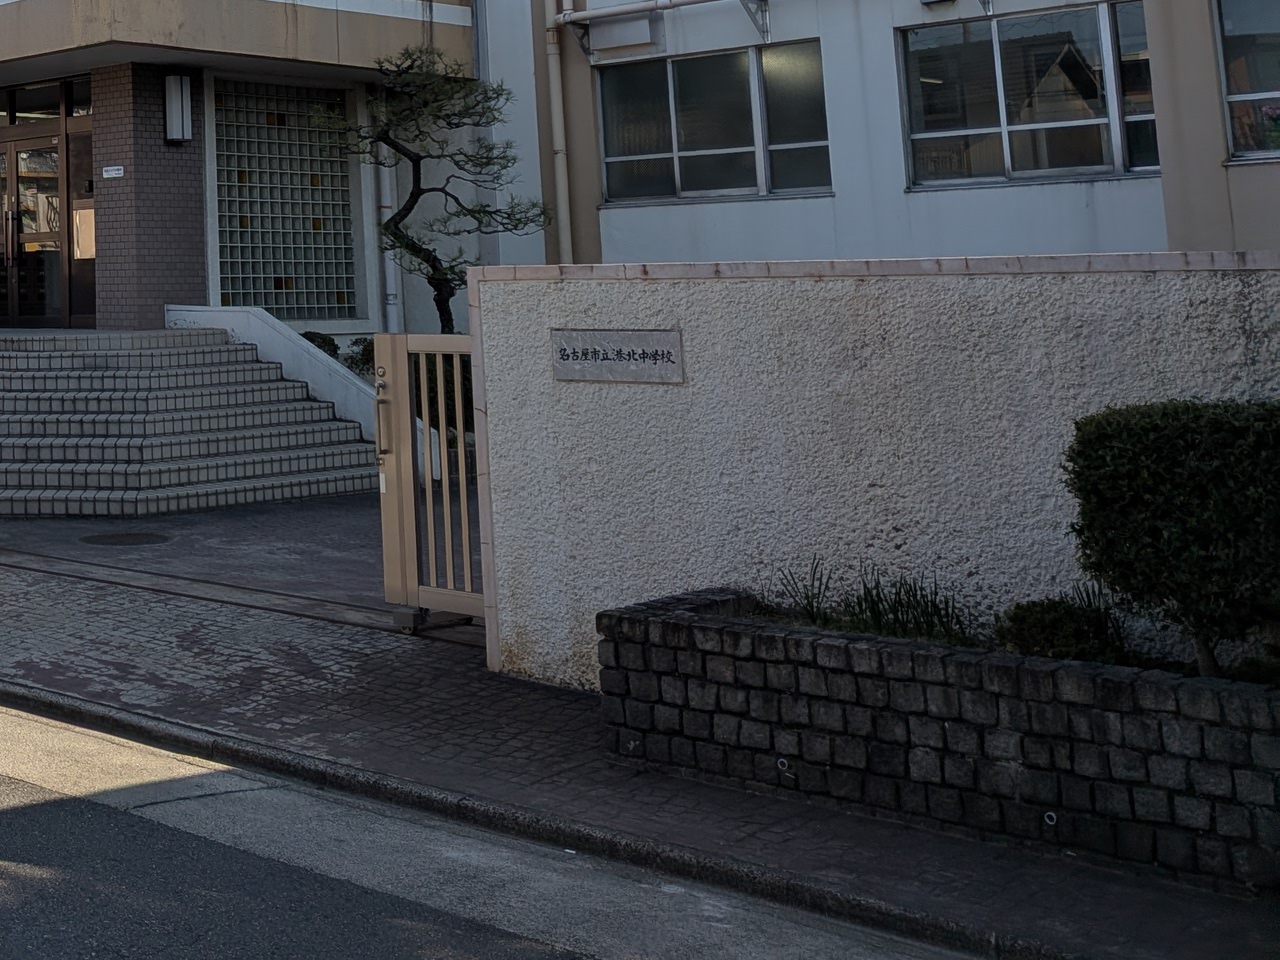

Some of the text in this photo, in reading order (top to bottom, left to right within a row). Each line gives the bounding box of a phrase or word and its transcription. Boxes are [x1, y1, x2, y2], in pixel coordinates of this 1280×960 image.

[558, 347, 676, 365] 名古屋市立港北中学校
